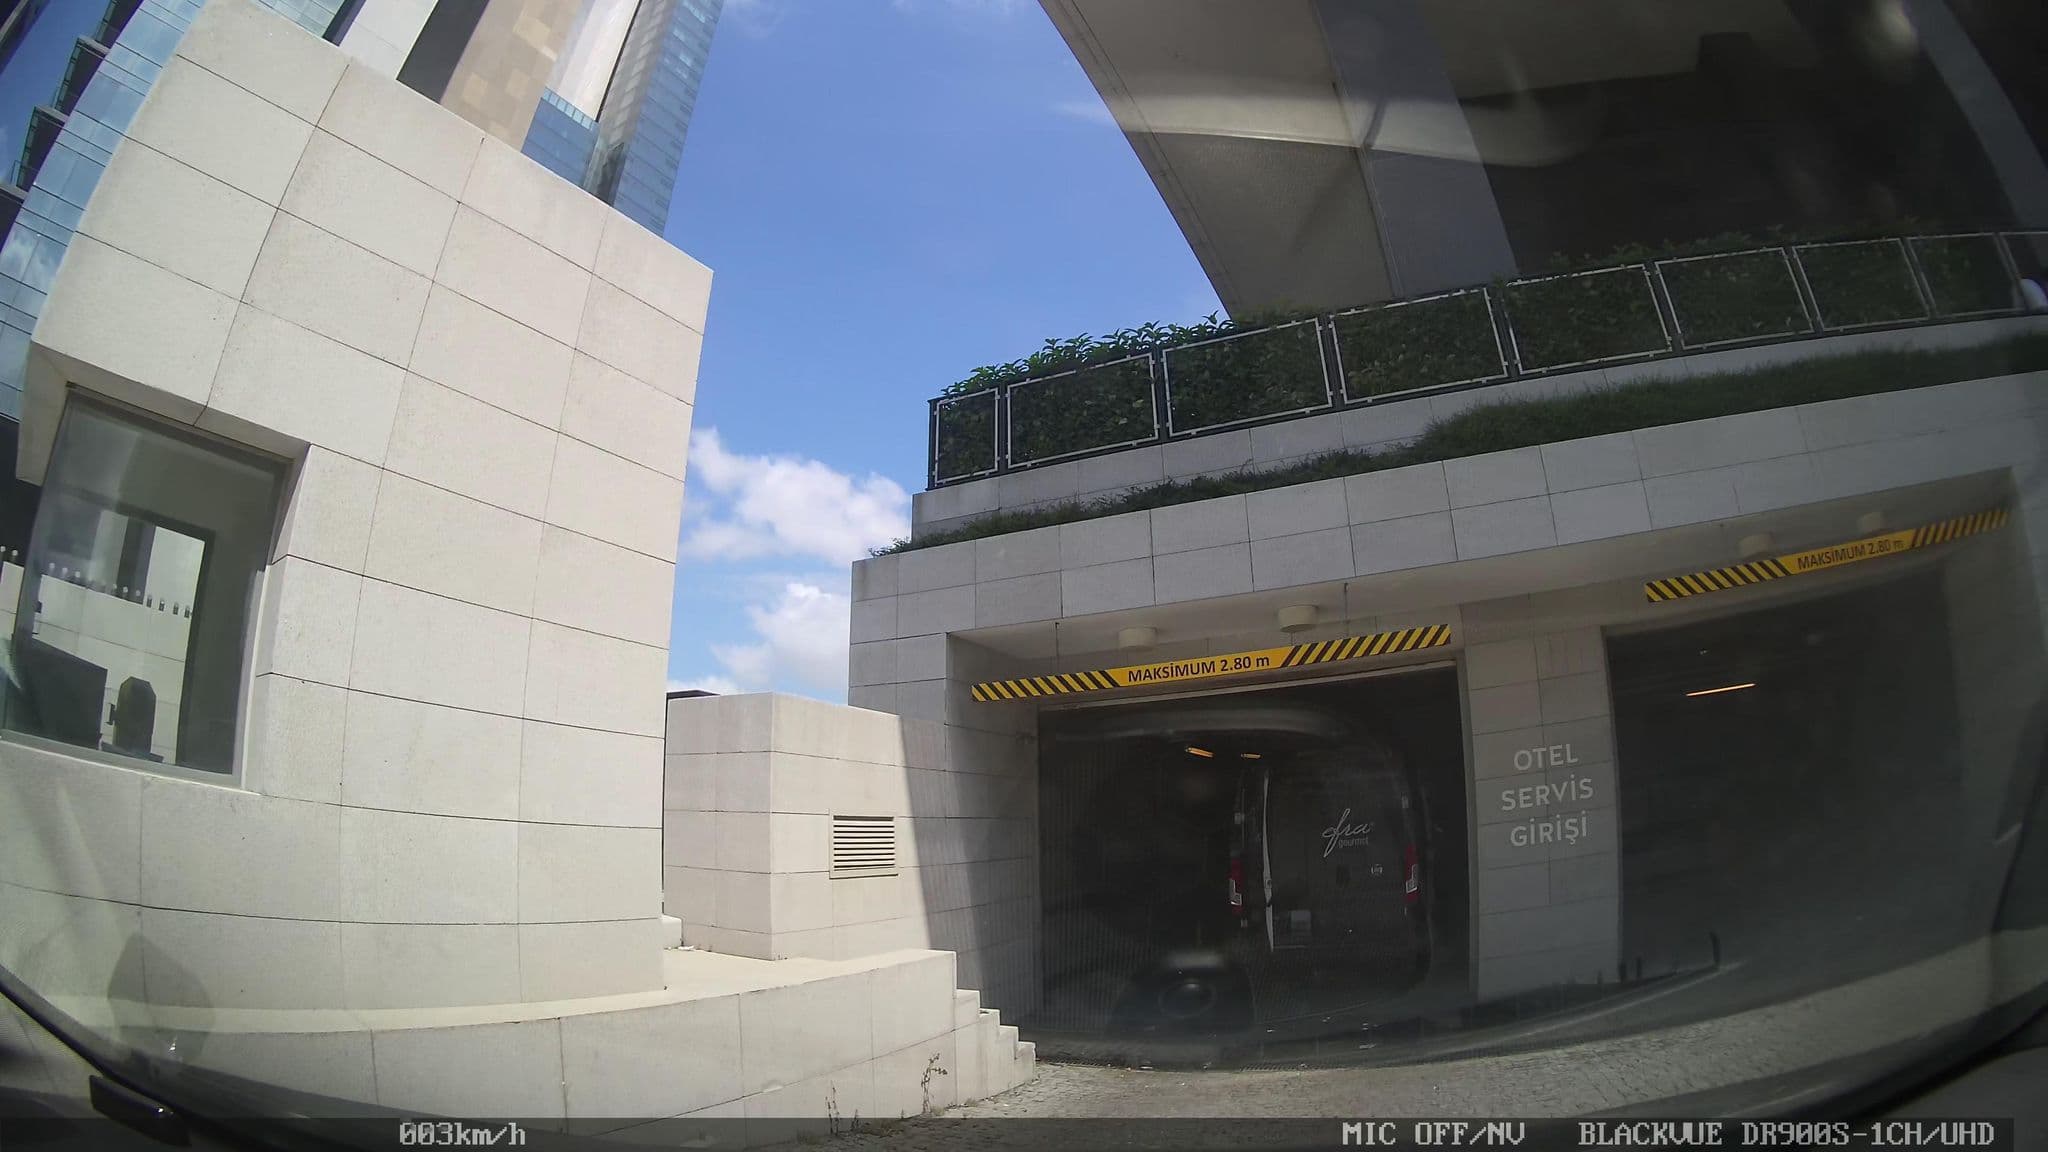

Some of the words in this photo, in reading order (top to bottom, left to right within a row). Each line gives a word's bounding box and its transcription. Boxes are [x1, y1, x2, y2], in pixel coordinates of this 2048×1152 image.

[1868, 539, 1892, 555] 2.80
[1128, 662, 1216, 683] MAKSİMUM
[1220, 656, 1251, 672] 2.80
[1255, 656, 1270, 667] m
[1513, 743, 1579, 771] OTEL
[1501, 774, 1594, 811] SERVİS
[1510, 810, 1587, 847] GİRİŞİ
